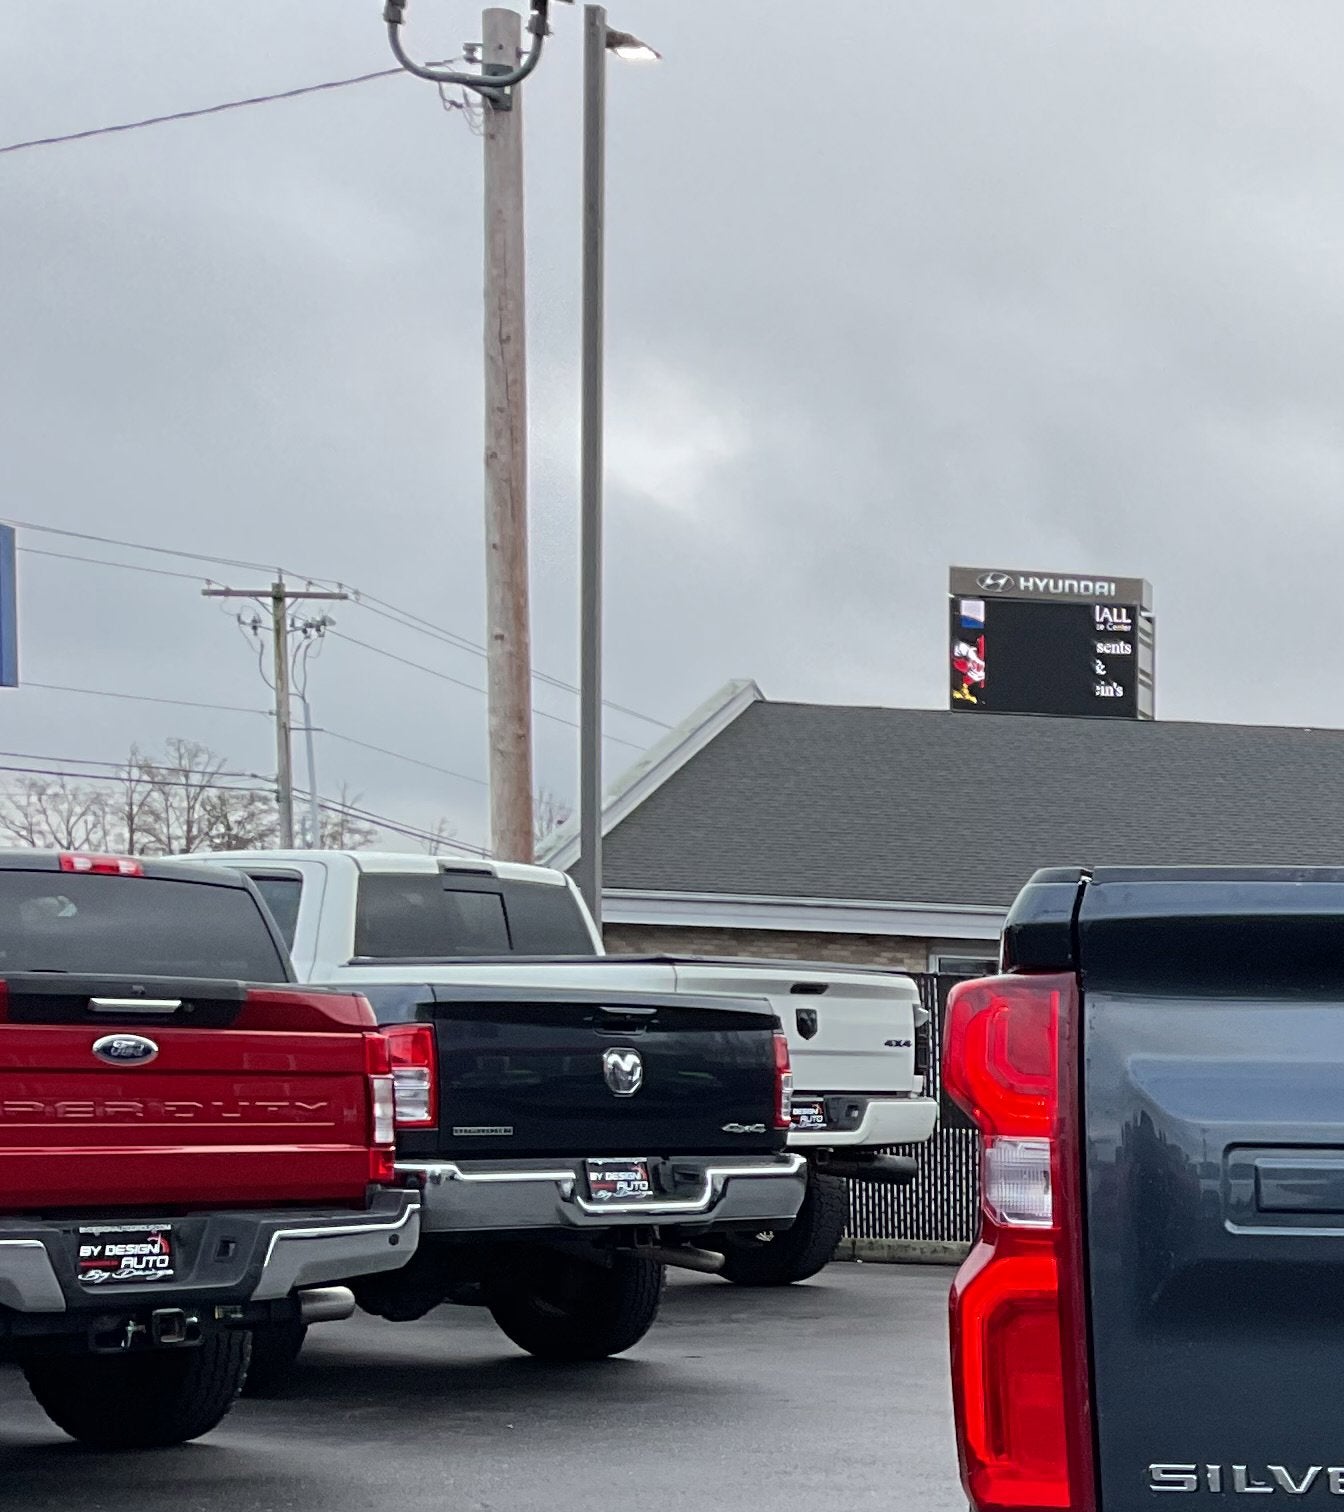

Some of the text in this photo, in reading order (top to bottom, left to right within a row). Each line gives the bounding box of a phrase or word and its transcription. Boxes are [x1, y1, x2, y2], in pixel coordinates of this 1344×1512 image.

[1019, 577, 1115, 596] HYUNDAI
[1095, 605, 1132, 623] ALL
[589, 1171, 642, 1181] BY DESIGN
[616, 1180, 649, 1191] AUTO
[80, 1243, 160, 1257] BY DESIGN
[120, 1255, 170, 1269] AUTO
